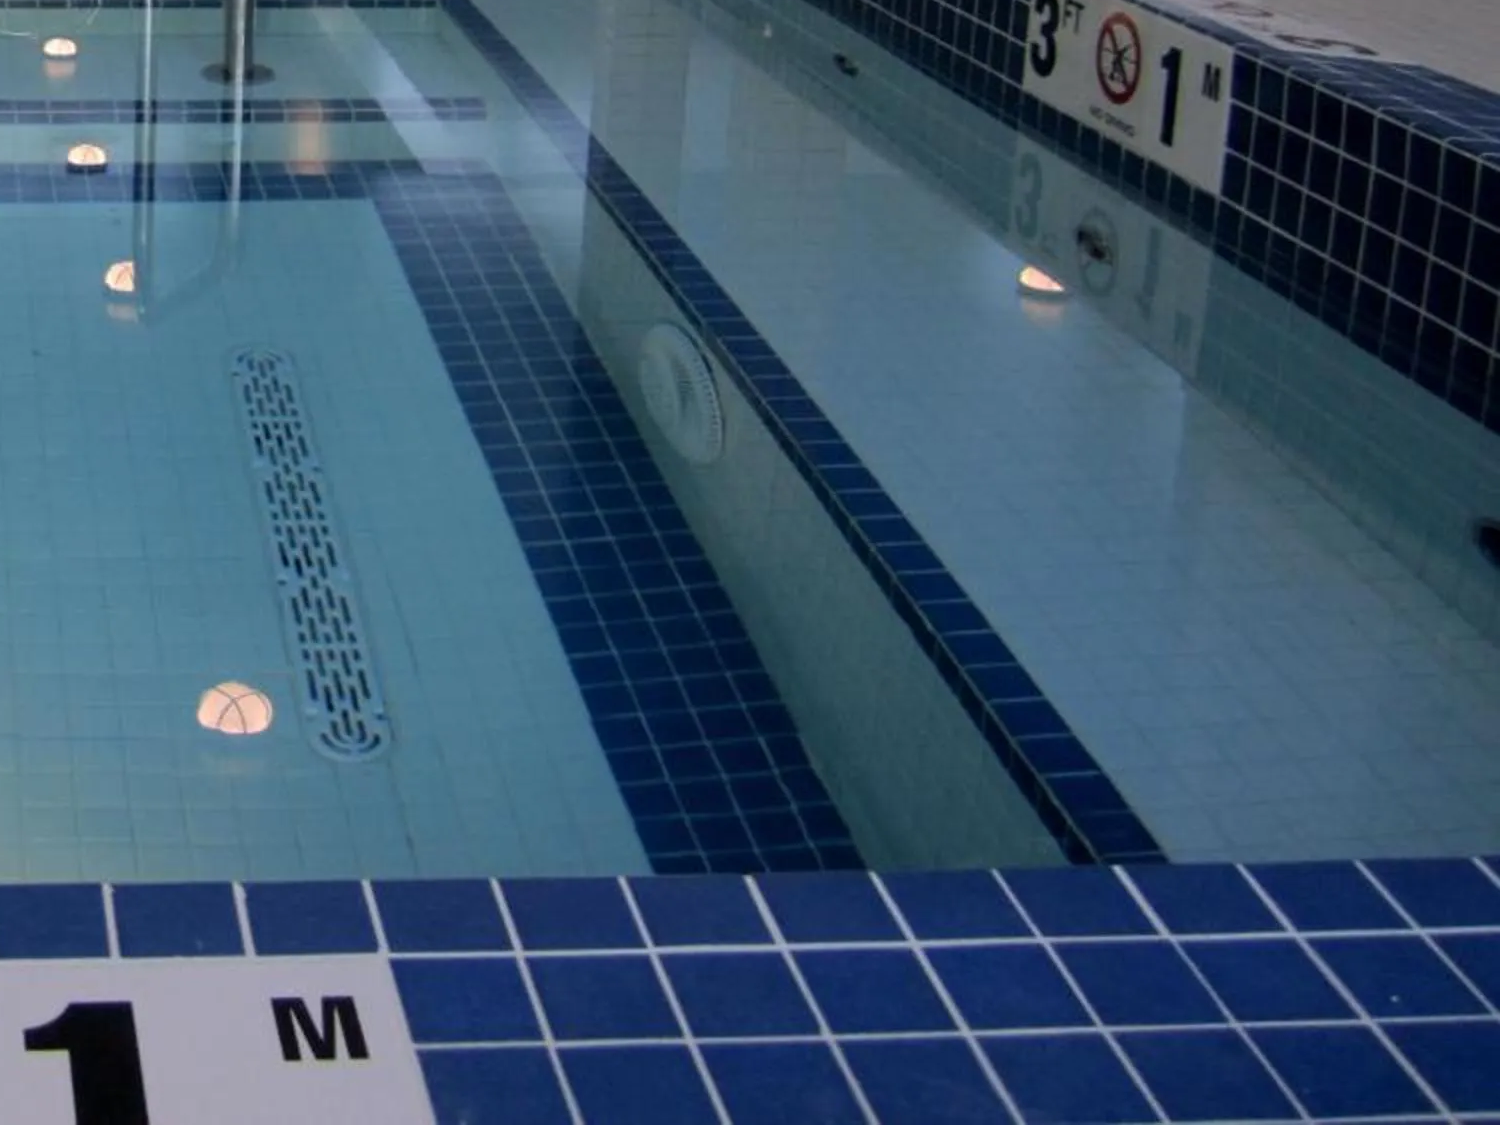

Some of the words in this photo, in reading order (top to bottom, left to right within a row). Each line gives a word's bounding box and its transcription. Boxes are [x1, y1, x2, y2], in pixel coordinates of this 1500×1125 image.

[1160, 46, 1182, 147] 1
[1202, 62, 1221, 103] M
[23, 1001, 151, 1125] 1
[270, 996, 370, 1061] M
